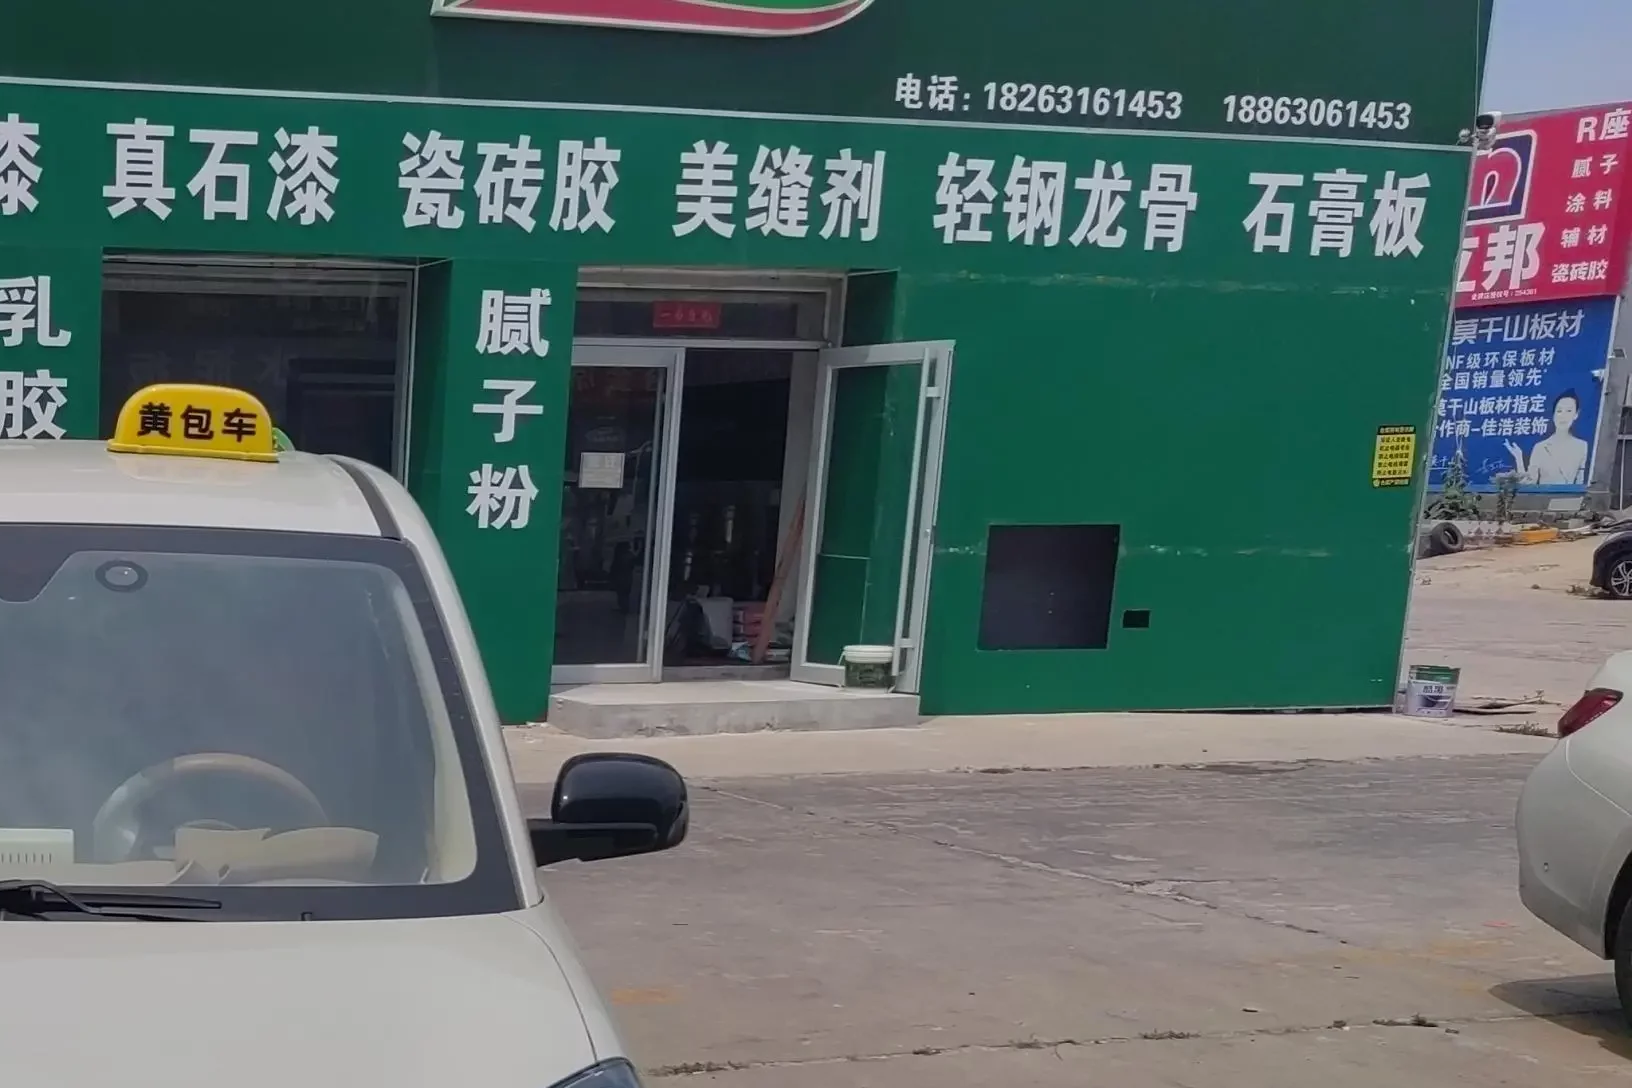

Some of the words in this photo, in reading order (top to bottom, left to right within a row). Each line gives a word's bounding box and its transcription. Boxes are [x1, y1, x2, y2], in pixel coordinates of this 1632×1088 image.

[983, 82, 1183, 121] 18263161453
[1222, 94, 1412, 131] 18863061453
[1576, 108, 1632, 143] R座
[103, 118, 340, 225] 真石漆
[399, 130, 621, 233] 瓷砖胶
[673, 140, 886, 242] 美缝剂
[934, 152, 1198, 253] 轻钢龙骨
[1243, 168, 1431, 258] 石膏板
[1565, 189, 1613, 213] 涂料
[1552, 259, 1609, 283] 瓷砖胶
[1452, 309, 1585, 345] 莫干山板材
[137, 402, 257, 442] 黄包车
[466, 288, 552, 529] 腻子粉
